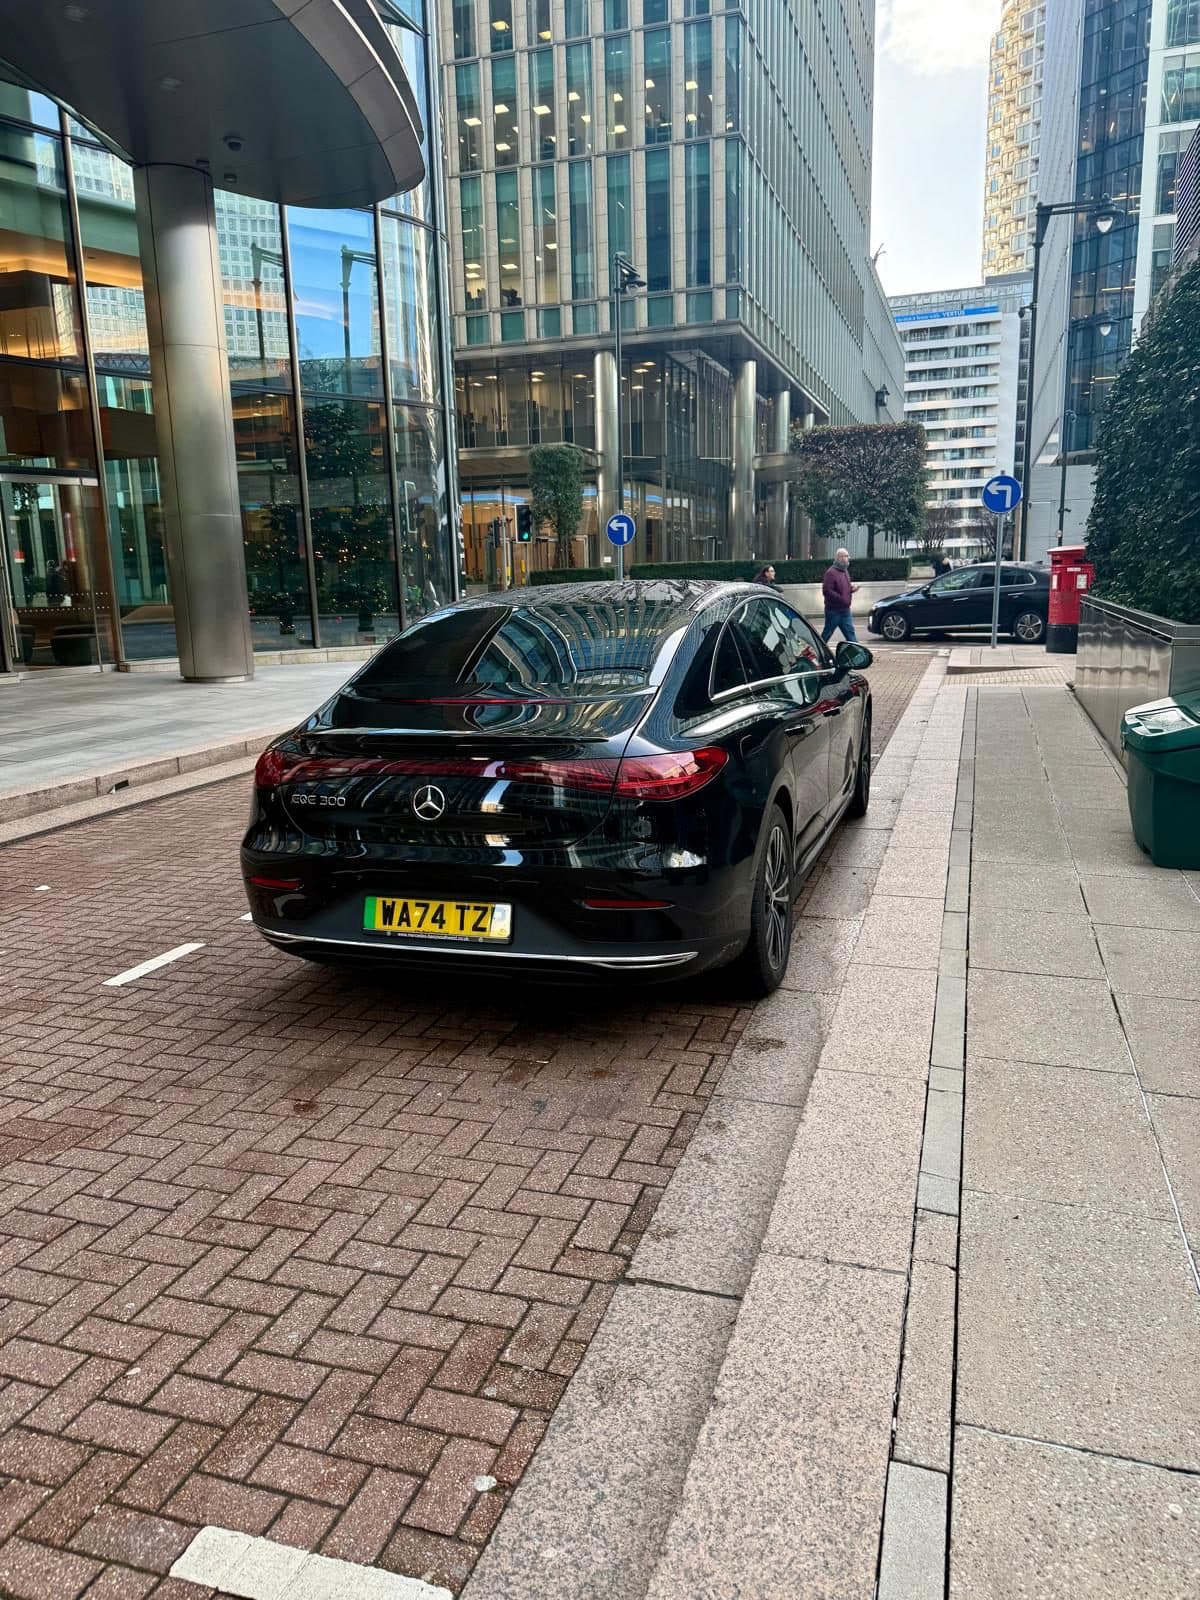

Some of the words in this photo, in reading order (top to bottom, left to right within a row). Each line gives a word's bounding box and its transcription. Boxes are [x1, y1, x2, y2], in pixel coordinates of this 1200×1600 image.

[291, 794, 317, 805] EQE
[319, 795, 346, 807] 300
[381, 899, 446, 930] WA74
[455, 904, 496, 933] TZ
